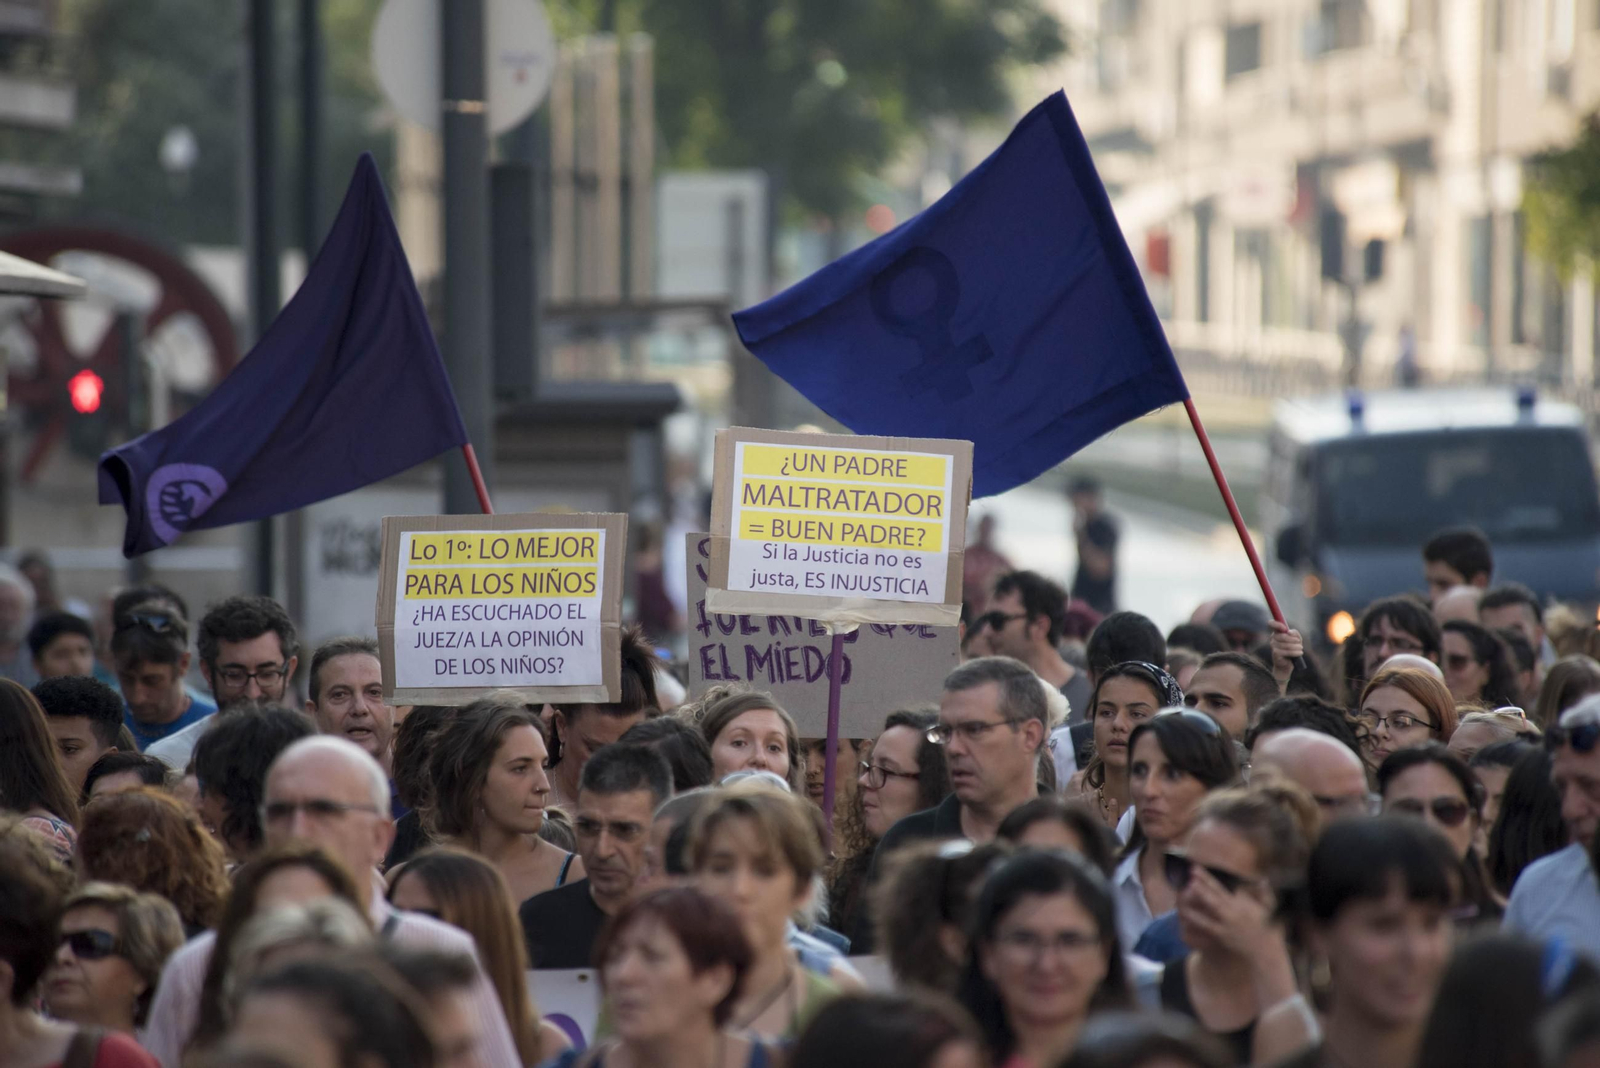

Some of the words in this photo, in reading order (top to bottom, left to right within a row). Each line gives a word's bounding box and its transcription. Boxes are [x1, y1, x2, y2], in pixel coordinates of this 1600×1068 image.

[780, 452, 826, 476] ¿UN
[833, 455, 908, 478] PADRE
[742, 483, 942, 517] MALTRATADOR
[771, 518, 834, 541] BUEN
[841, 523, 926, 547] PADRE?
[411, 539, 437, 560] Lo
[479, 538, 509, 559] LO
[515, 536, 595, 559] MEJOR
[762, 543, 778, 560] Si
[783, 544, 798, 561] la
[803, 546, 869, 566] Justicia
[874, 554, 898, 567] no
[903, 556, 922, 569] es
[405, 573, 464, 596] PARA
[471, 573, 514, 595] LOS
[521, 568, 596, 594] NIÑOS
[750, 569, 799, 590] justa,
[805, 571, 825, 589] ES
[831, 573, 929, 596] INJUSTICIA
[412, 605, 446, 626] ¿HA
[451, 604, 562, 621] ESCUCHADO
[567, 603, 587, 620] EL
[414, 631, 476, 649] JUEZ/A
[481, 631, 503, 648] LA
[507, 627, 584, 647] OPINIÓN
[435, 658, 458, 675] DE
[463, 658, 495, 675] LOS
[501, 655, 564, 675] NIÑOS?
[700, 643, 741, 681] EL
